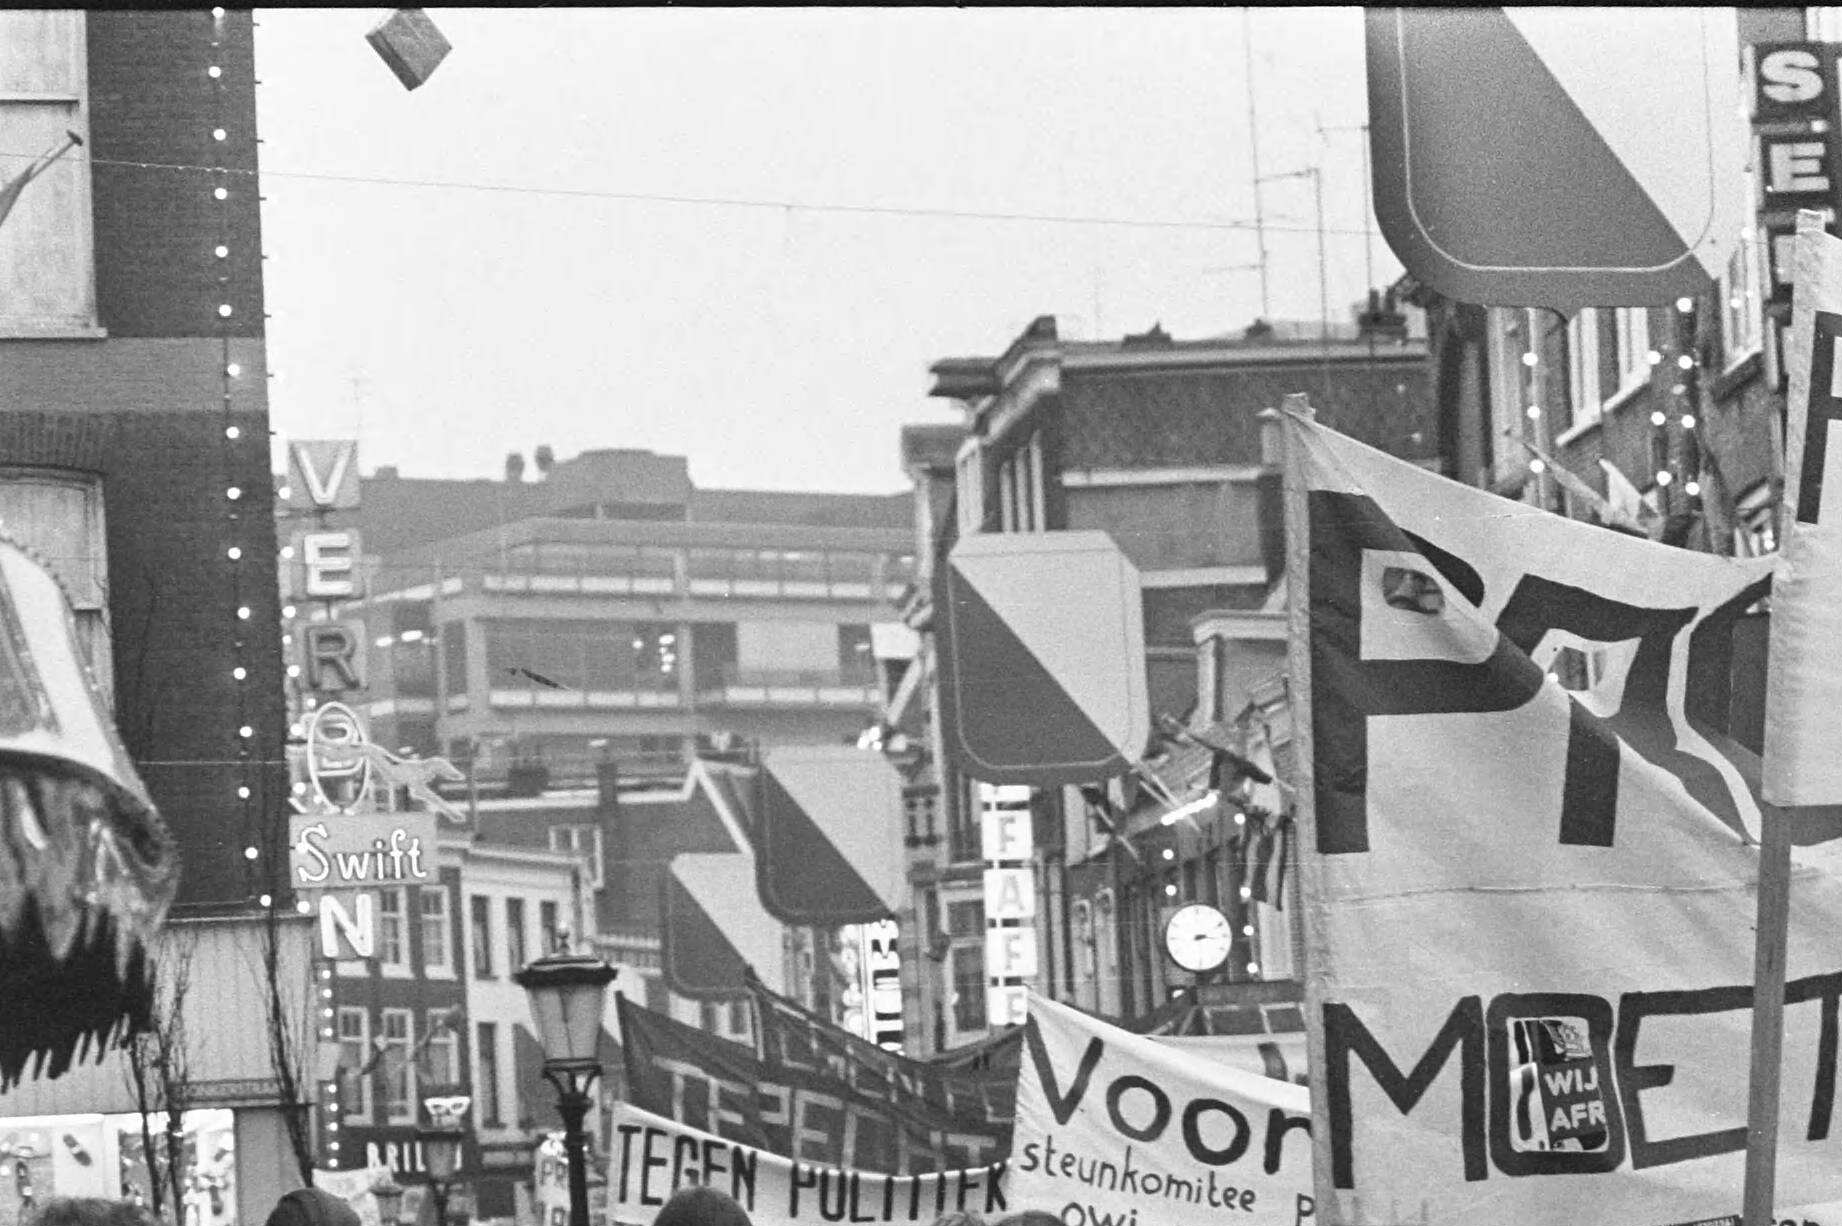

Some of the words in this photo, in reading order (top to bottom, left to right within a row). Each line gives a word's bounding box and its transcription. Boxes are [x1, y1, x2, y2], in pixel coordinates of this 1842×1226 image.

[297, 823, 427, 882] Swift
[1543, 1067, 1598, 1097] WIJ
[1550, 1100, 1607, 1133] AFR
[617, 1123, 758, 1212] TEGEN
[1020, 1134, 1257, 1213] steunkomitee
